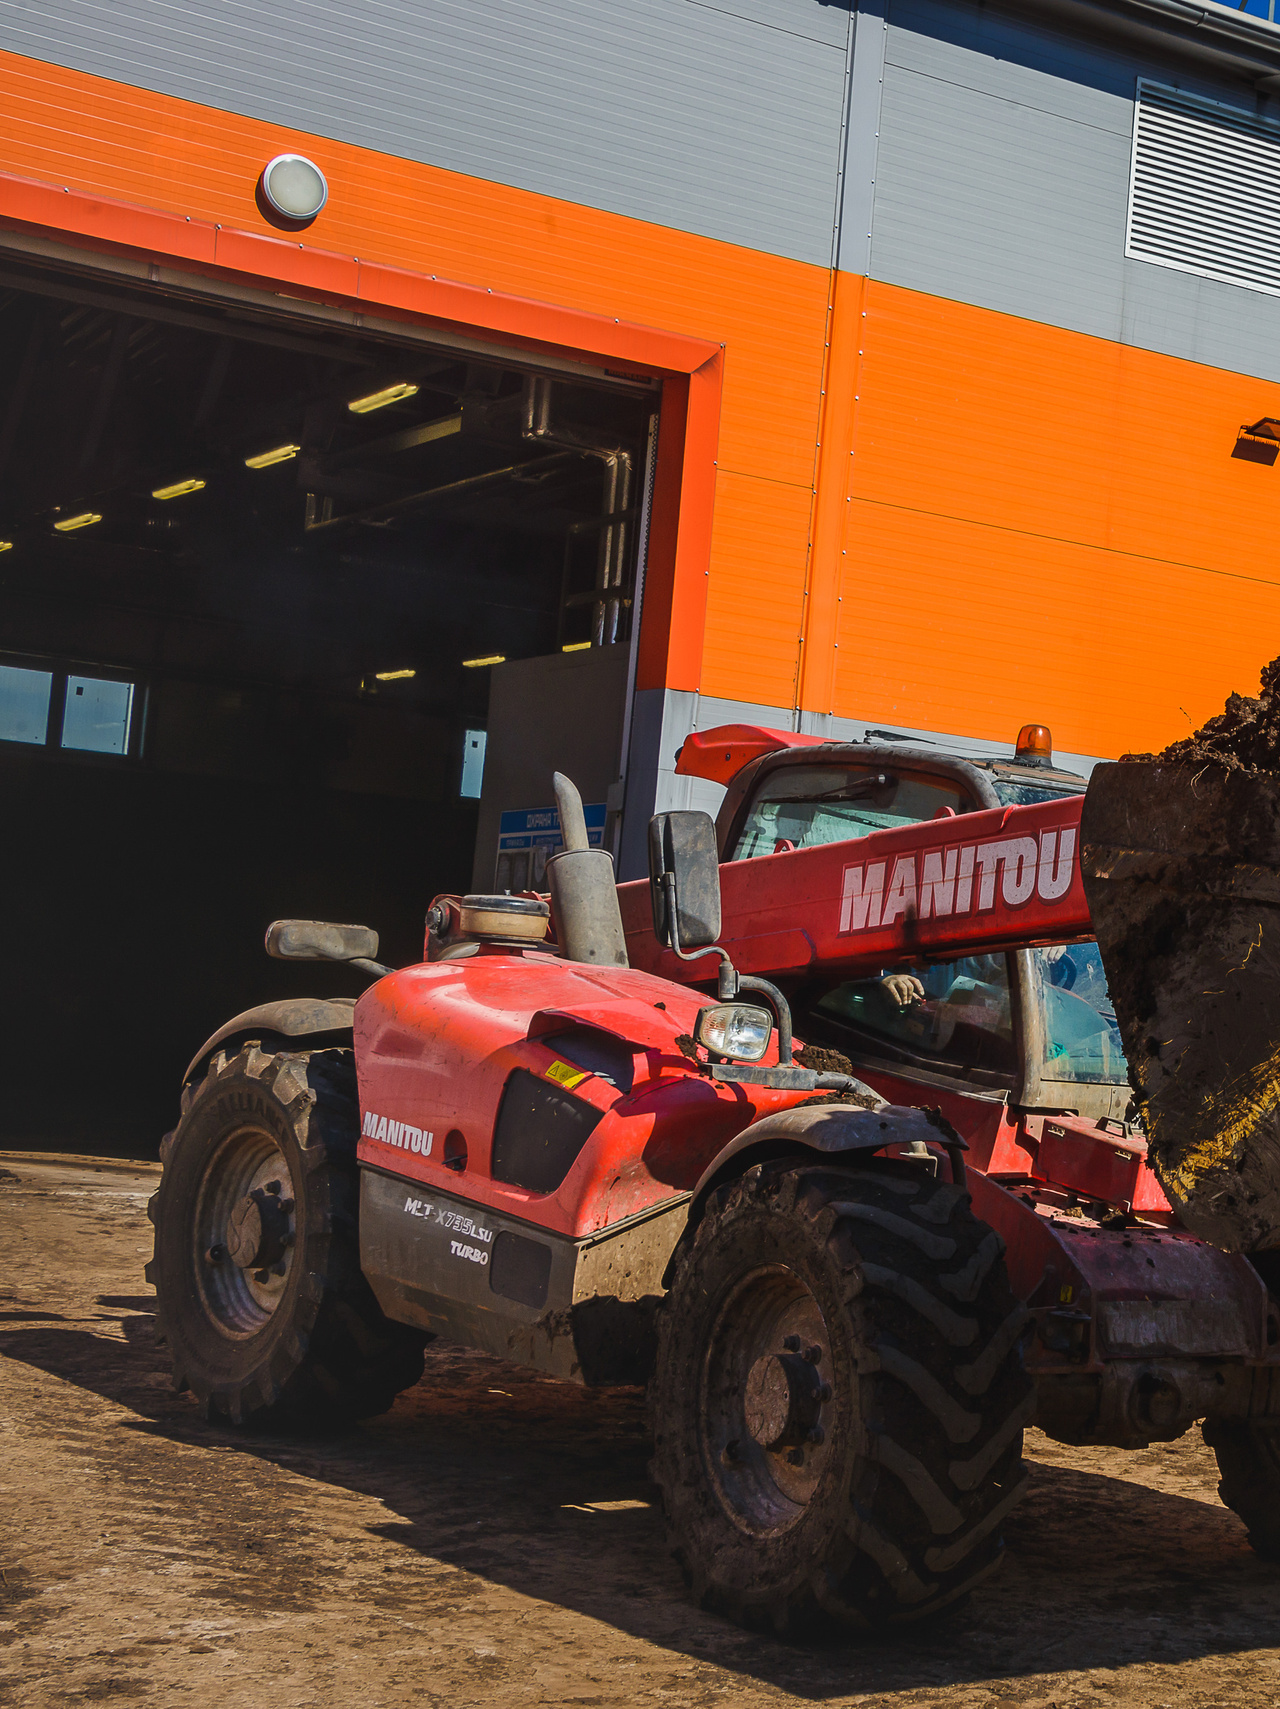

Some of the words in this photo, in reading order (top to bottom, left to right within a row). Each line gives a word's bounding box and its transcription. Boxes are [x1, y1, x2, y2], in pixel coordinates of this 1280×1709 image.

[838, 827, 1077, 933] MANITOU
[362, 1111, 434, 1157] MANITOU
[450, 1240, 489, 1266] TURBO
